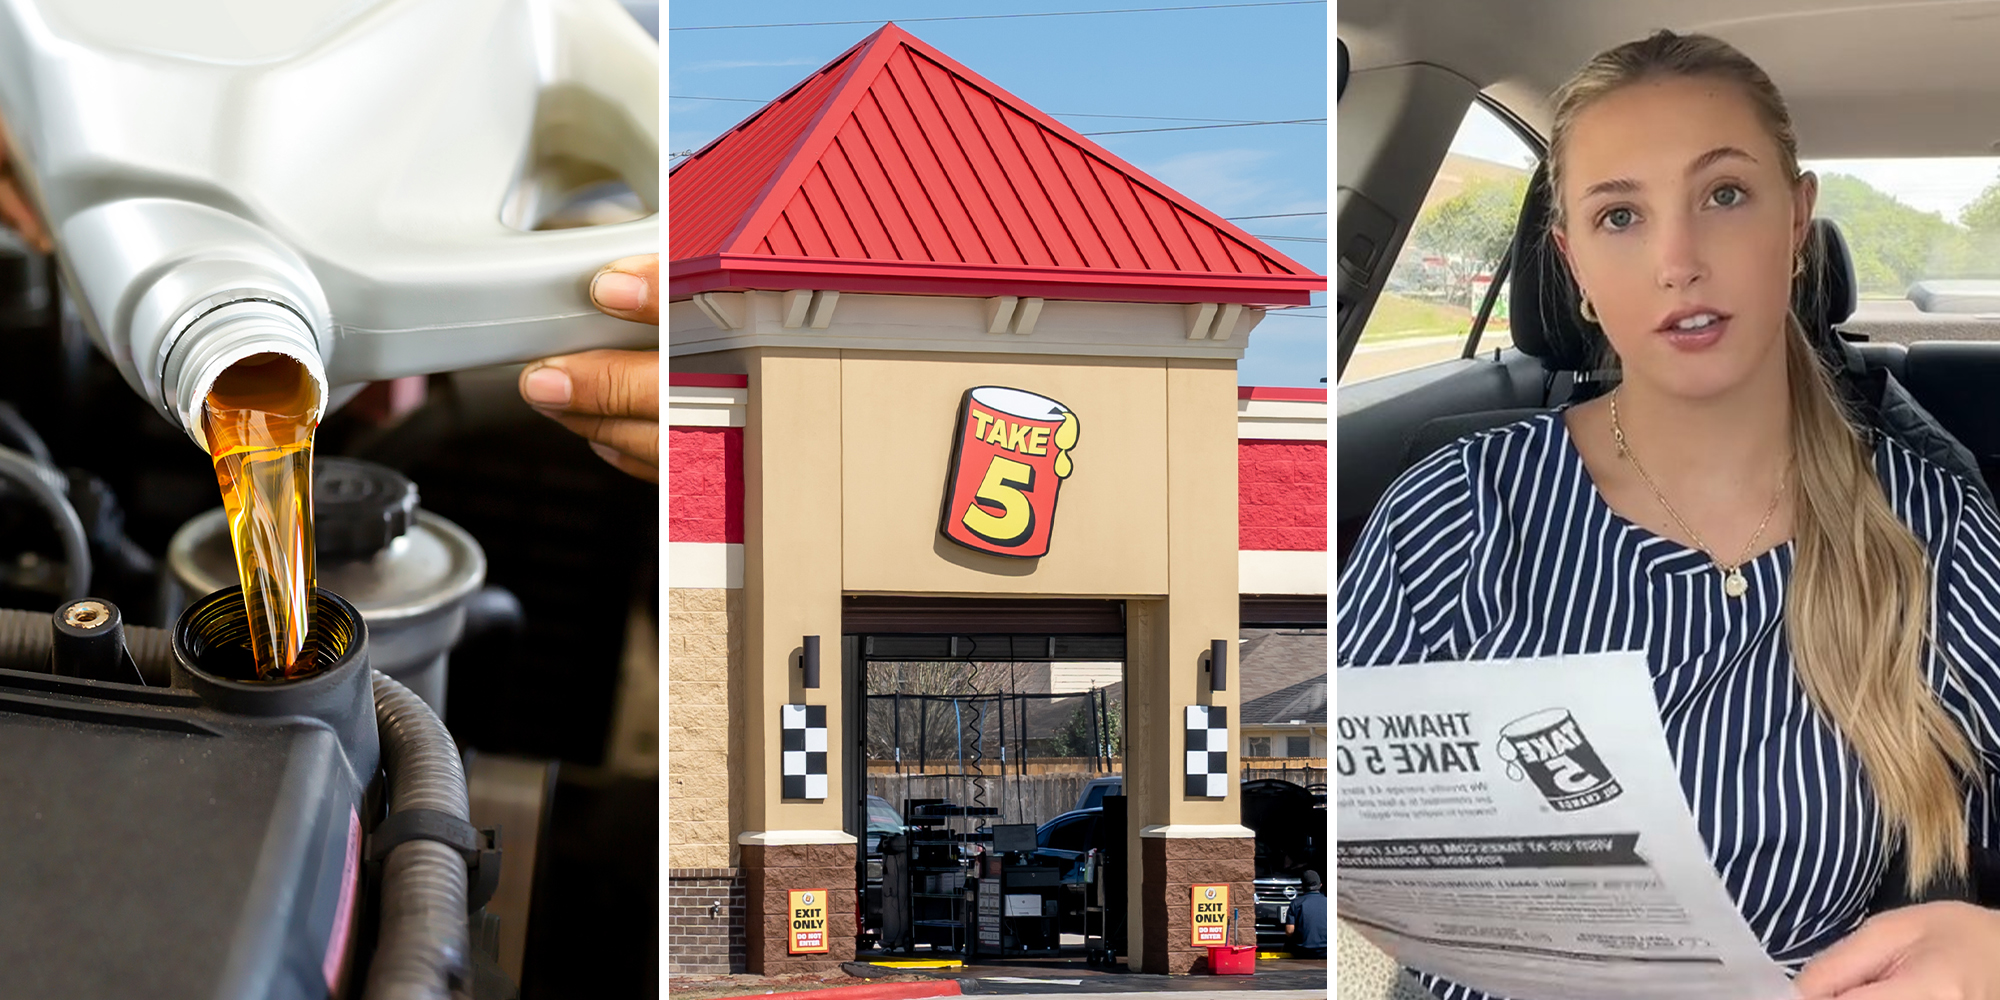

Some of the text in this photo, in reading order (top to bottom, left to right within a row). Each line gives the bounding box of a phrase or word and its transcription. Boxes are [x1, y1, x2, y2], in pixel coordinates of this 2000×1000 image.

[972, 408, 1051, 457] TAKE
[961, 454, 1036, 547] 5
[1198, 903, 1222, 912] EXIT
[795, 908, 821, 918] EXIT
[1195, 914, 1225, 923] ONLY
[793, 919, 824, 929] ONLY
